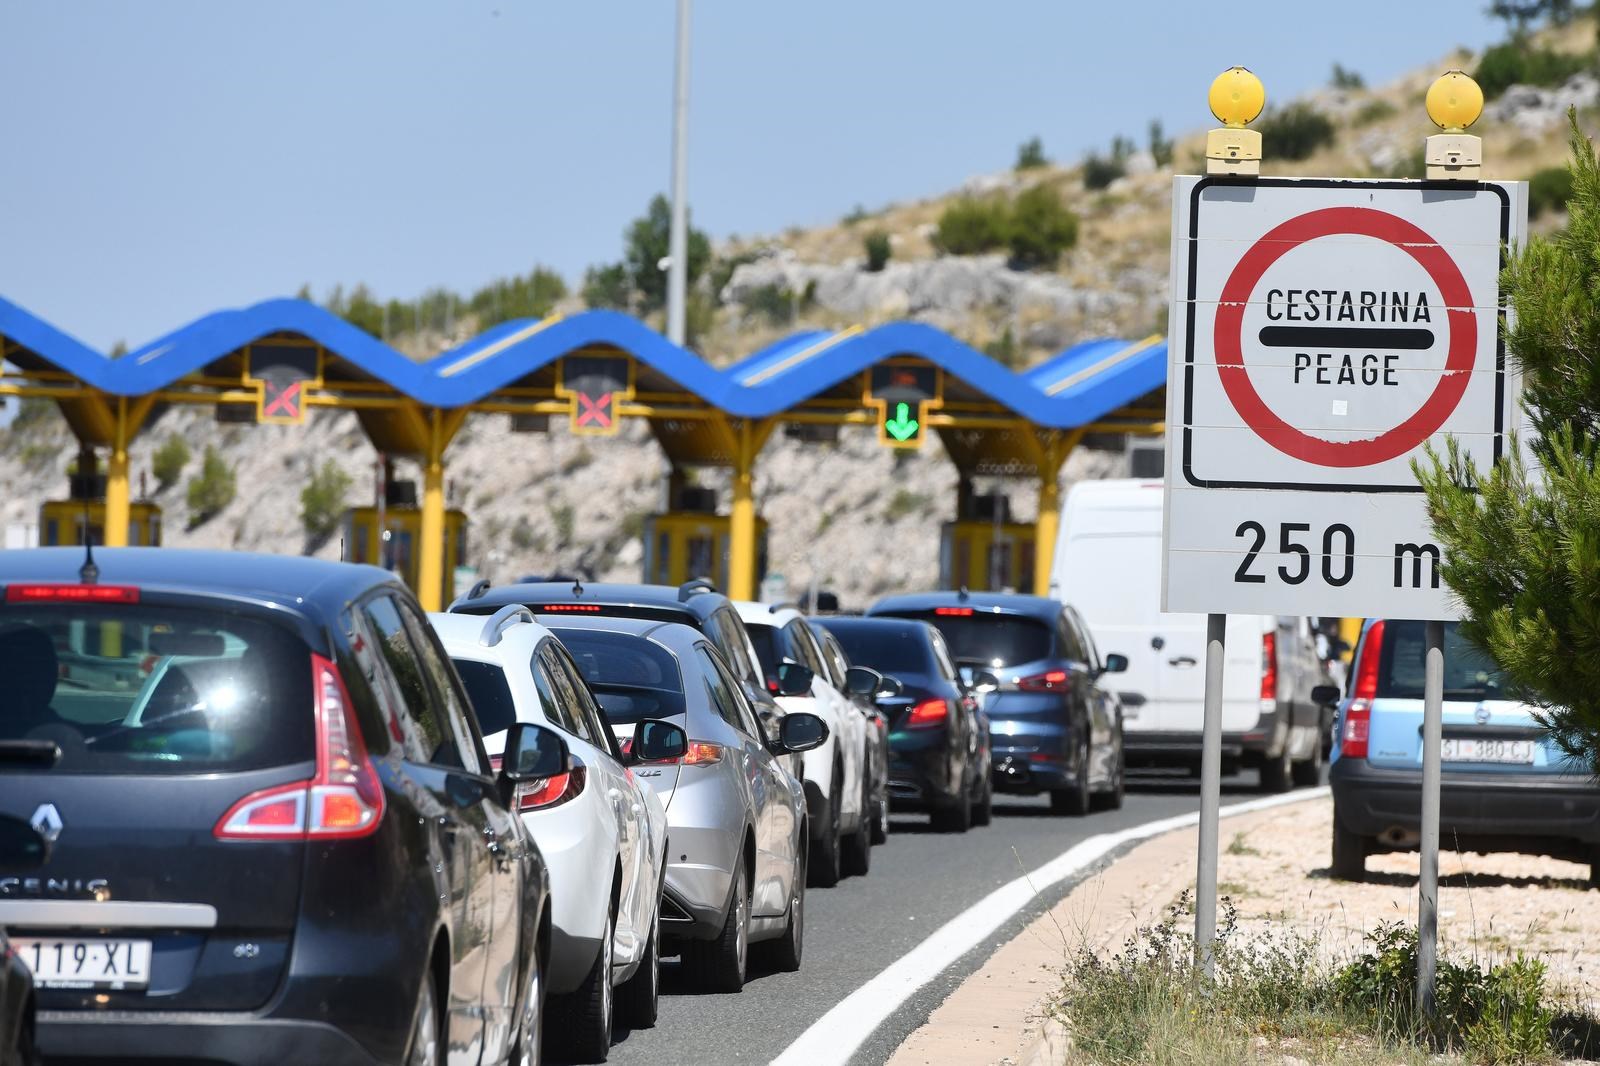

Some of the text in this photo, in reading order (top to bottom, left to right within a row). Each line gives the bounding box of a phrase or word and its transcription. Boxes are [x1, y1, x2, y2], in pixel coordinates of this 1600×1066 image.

[1266, 289, 1431, 323] CESTARINA
[1294, 353, 1399, 386] PEAGE
[1234, 520, 1440, 588] 250 m
